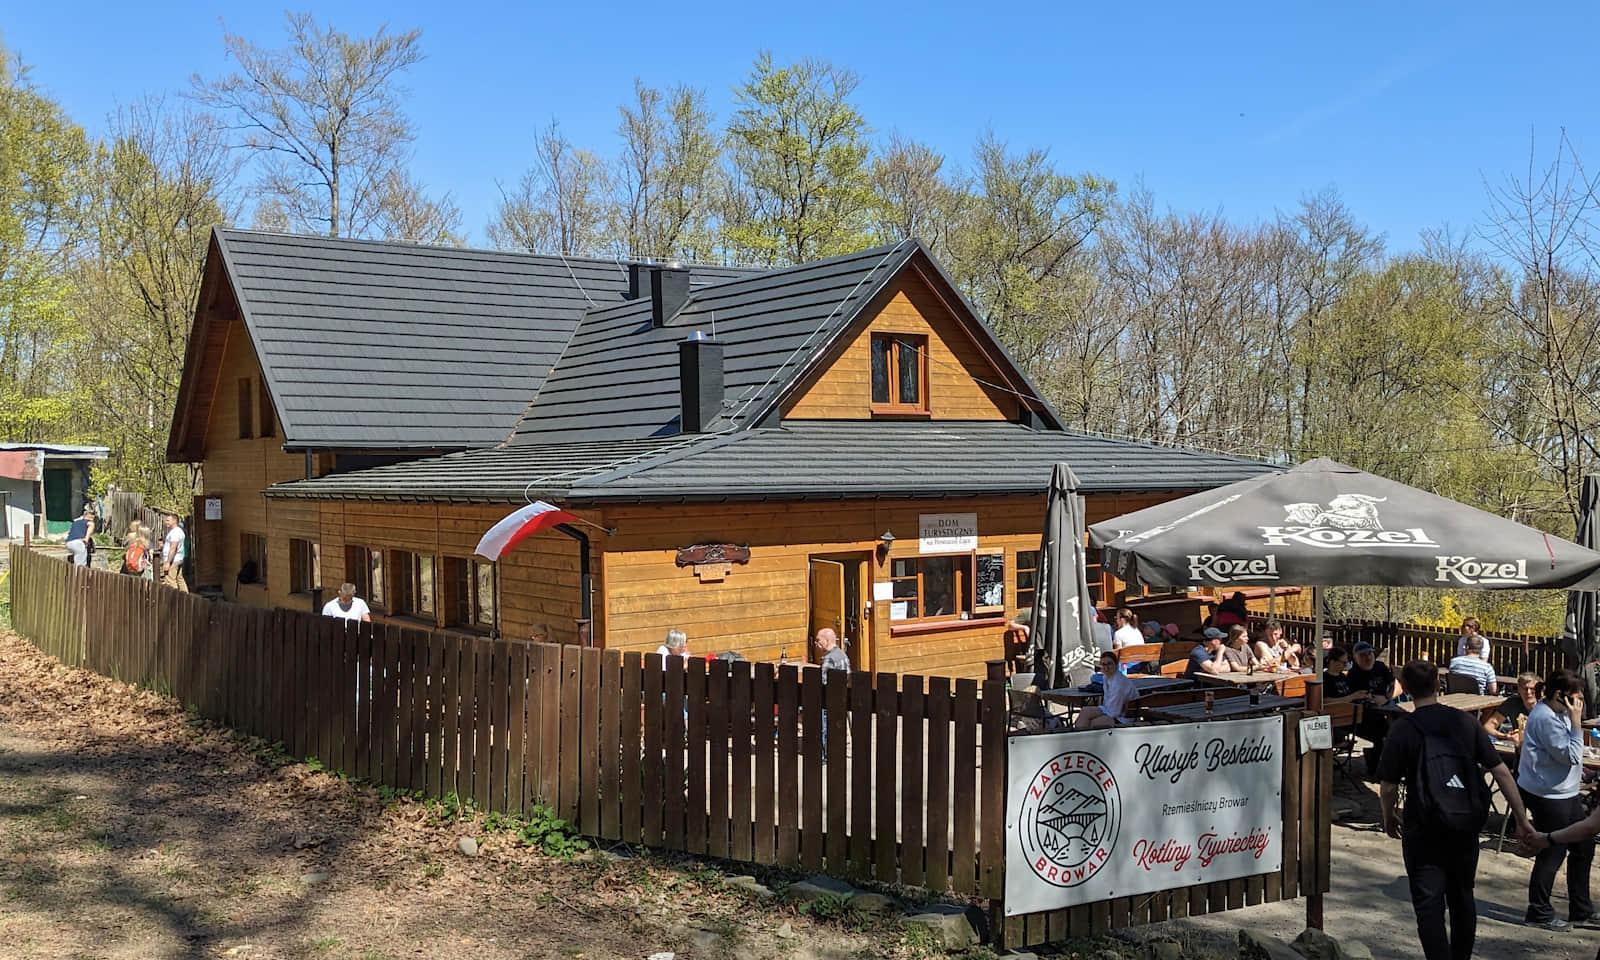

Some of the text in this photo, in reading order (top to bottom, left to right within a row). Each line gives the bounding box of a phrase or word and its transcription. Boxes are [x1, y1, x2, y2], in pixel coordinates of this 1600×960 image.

[924, 527, 974, 538] TURYSTYCZNY
[938, 519, 959, 528] DOM
[1258, 526, 1441, 548] Kozel
[1186, 554, 1281, 583] Kozel
[1435, 555, 1529, 585] Kozel
[1134, 736, 1273, 784] Klasyk Beskidu
[1030, 755, 1114, 800] ZARZECZE
[1162, 797, 1249, 817] Rzemieślniczy Browar
[1133, 826, 1272, 872] Kotliny Żywieckiej
[1035, 847, 1108, 884] BROWAR
